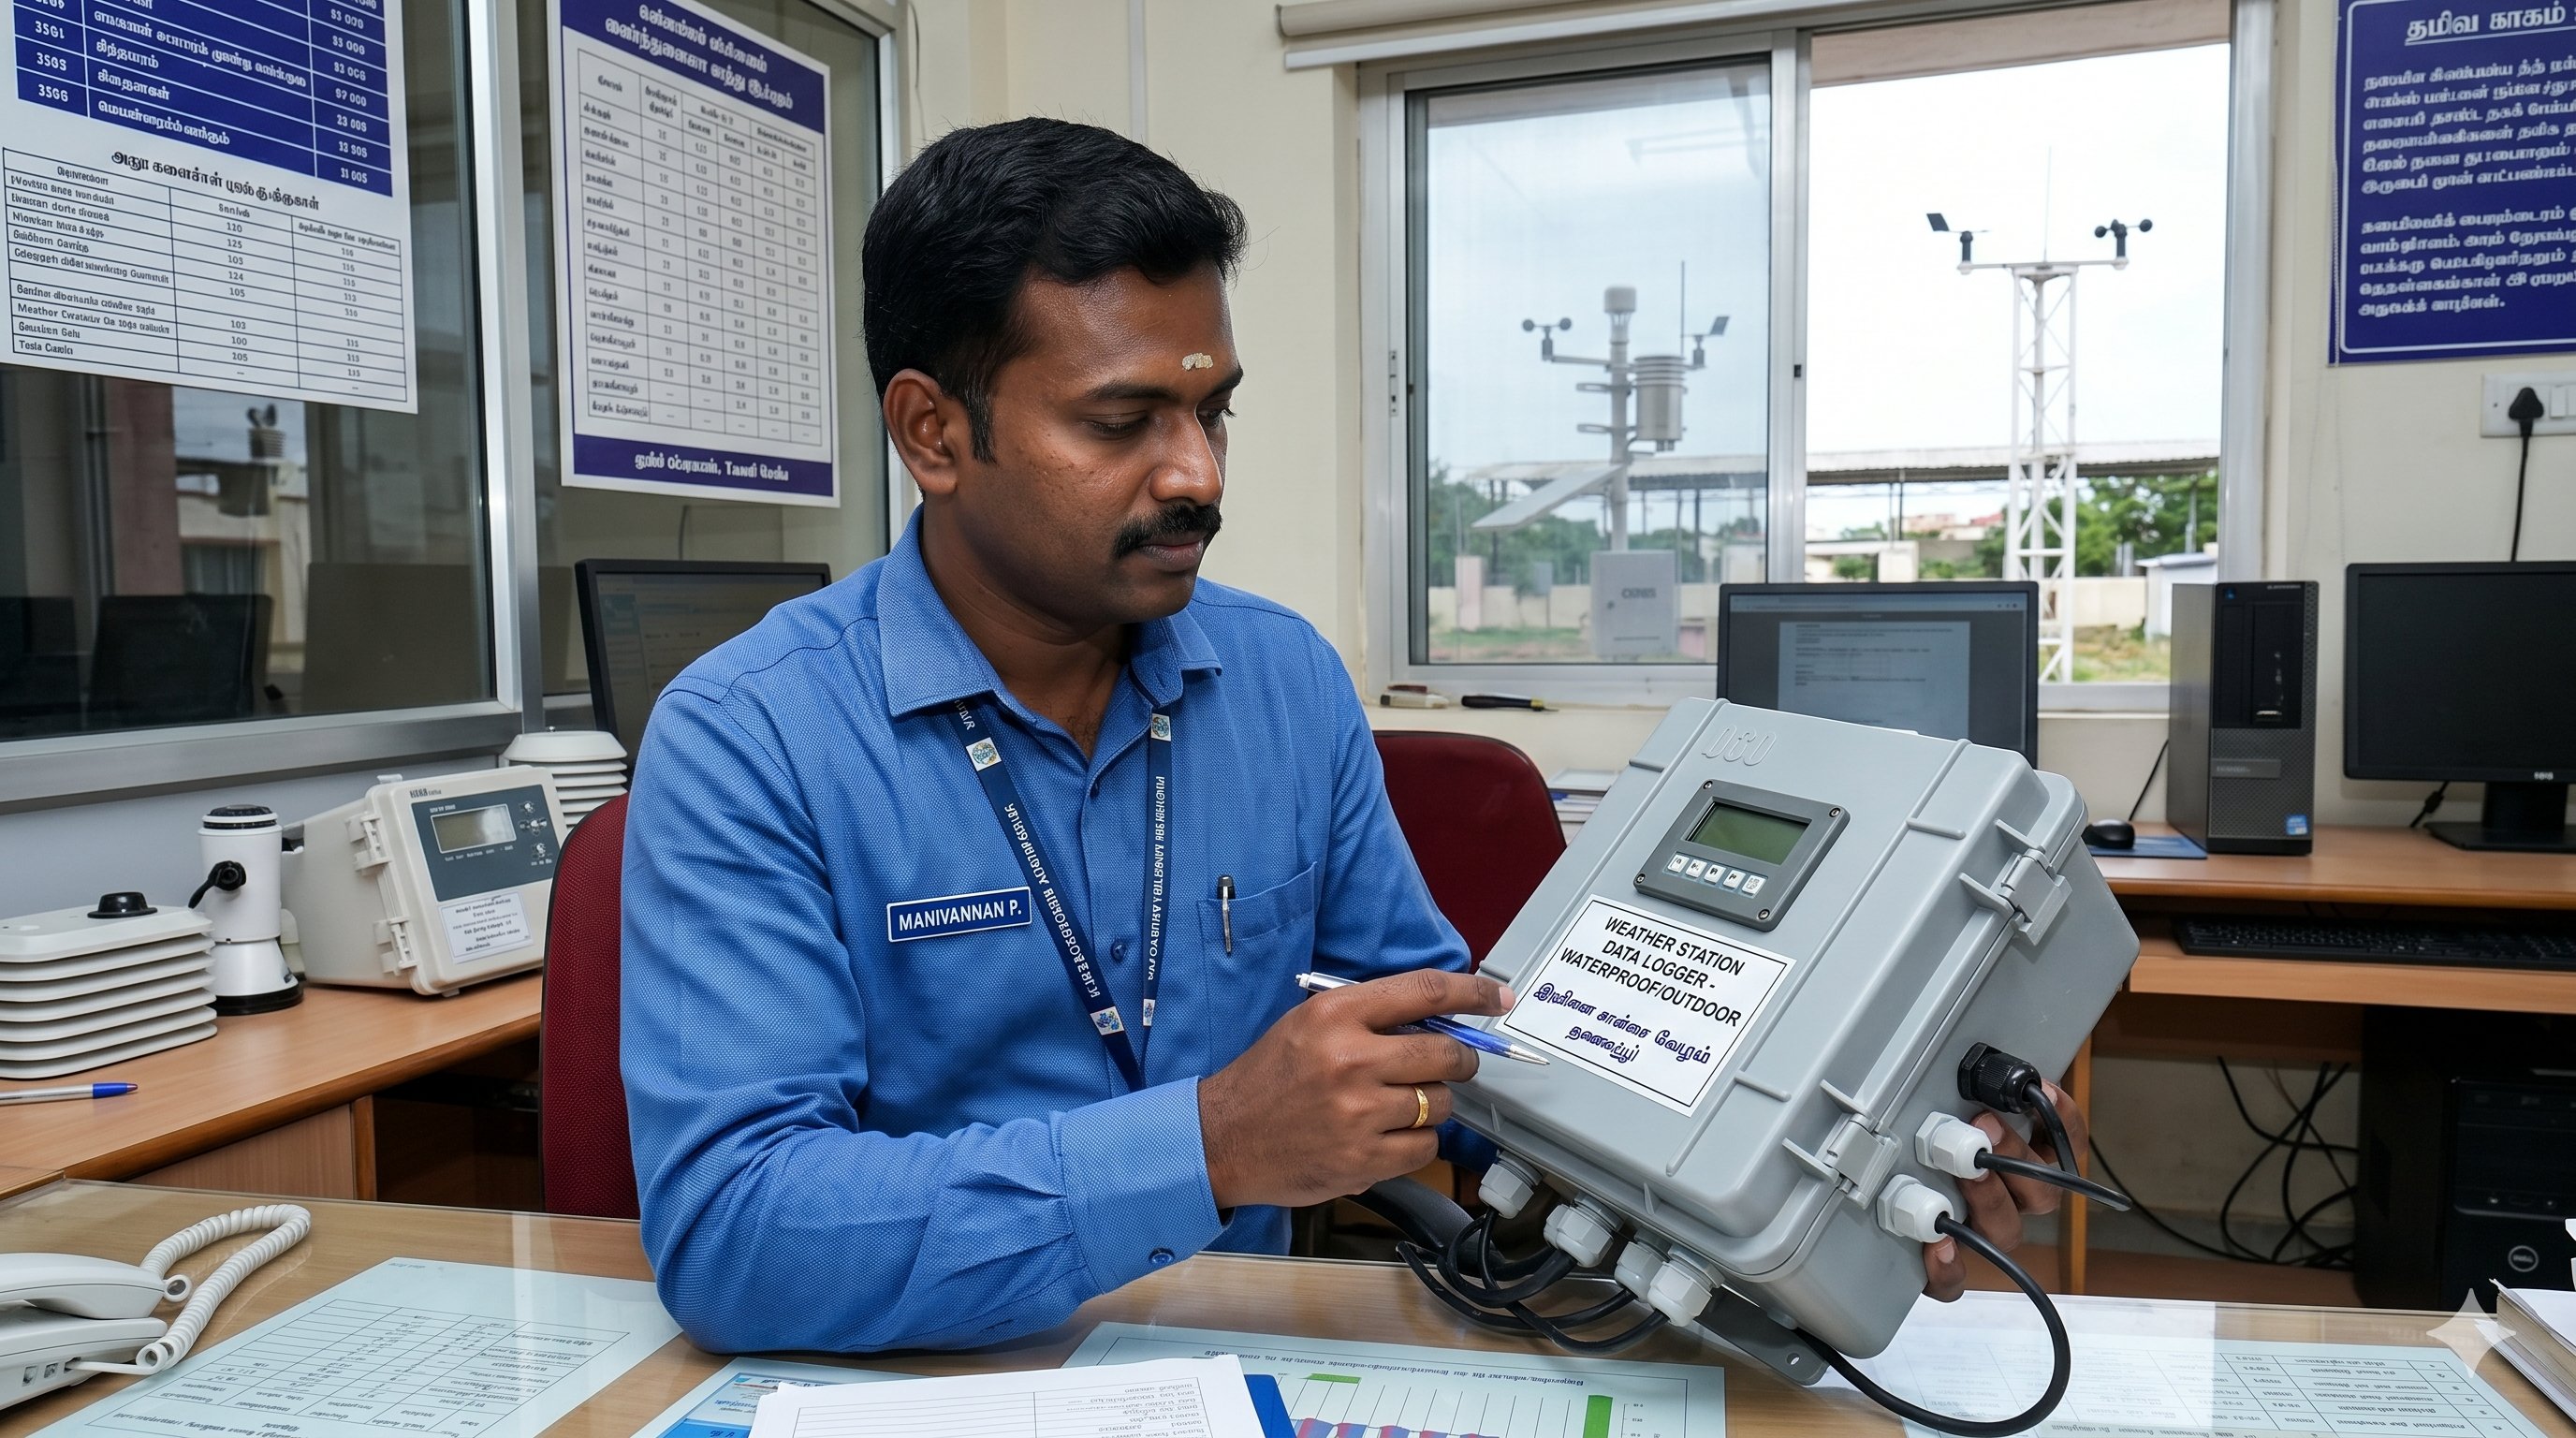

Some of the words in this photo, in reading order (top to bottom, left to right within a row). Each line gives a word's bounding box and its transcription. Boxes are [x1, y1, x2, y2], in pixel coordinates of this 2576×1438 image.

[898, 902, 1003, 932] MANIVANNAN
[1009, 899, 1023, 918] P.
[1602, 939, 1640, 965] DATA
[1641, 953, 1708, 990] LOGGER
[1604, 916, 1677, 953] WEATHER
[1677, 942, 1747, 976] STATION
[1559, 947, 1743, 1028] WATERPROOF/OUTDOOR
